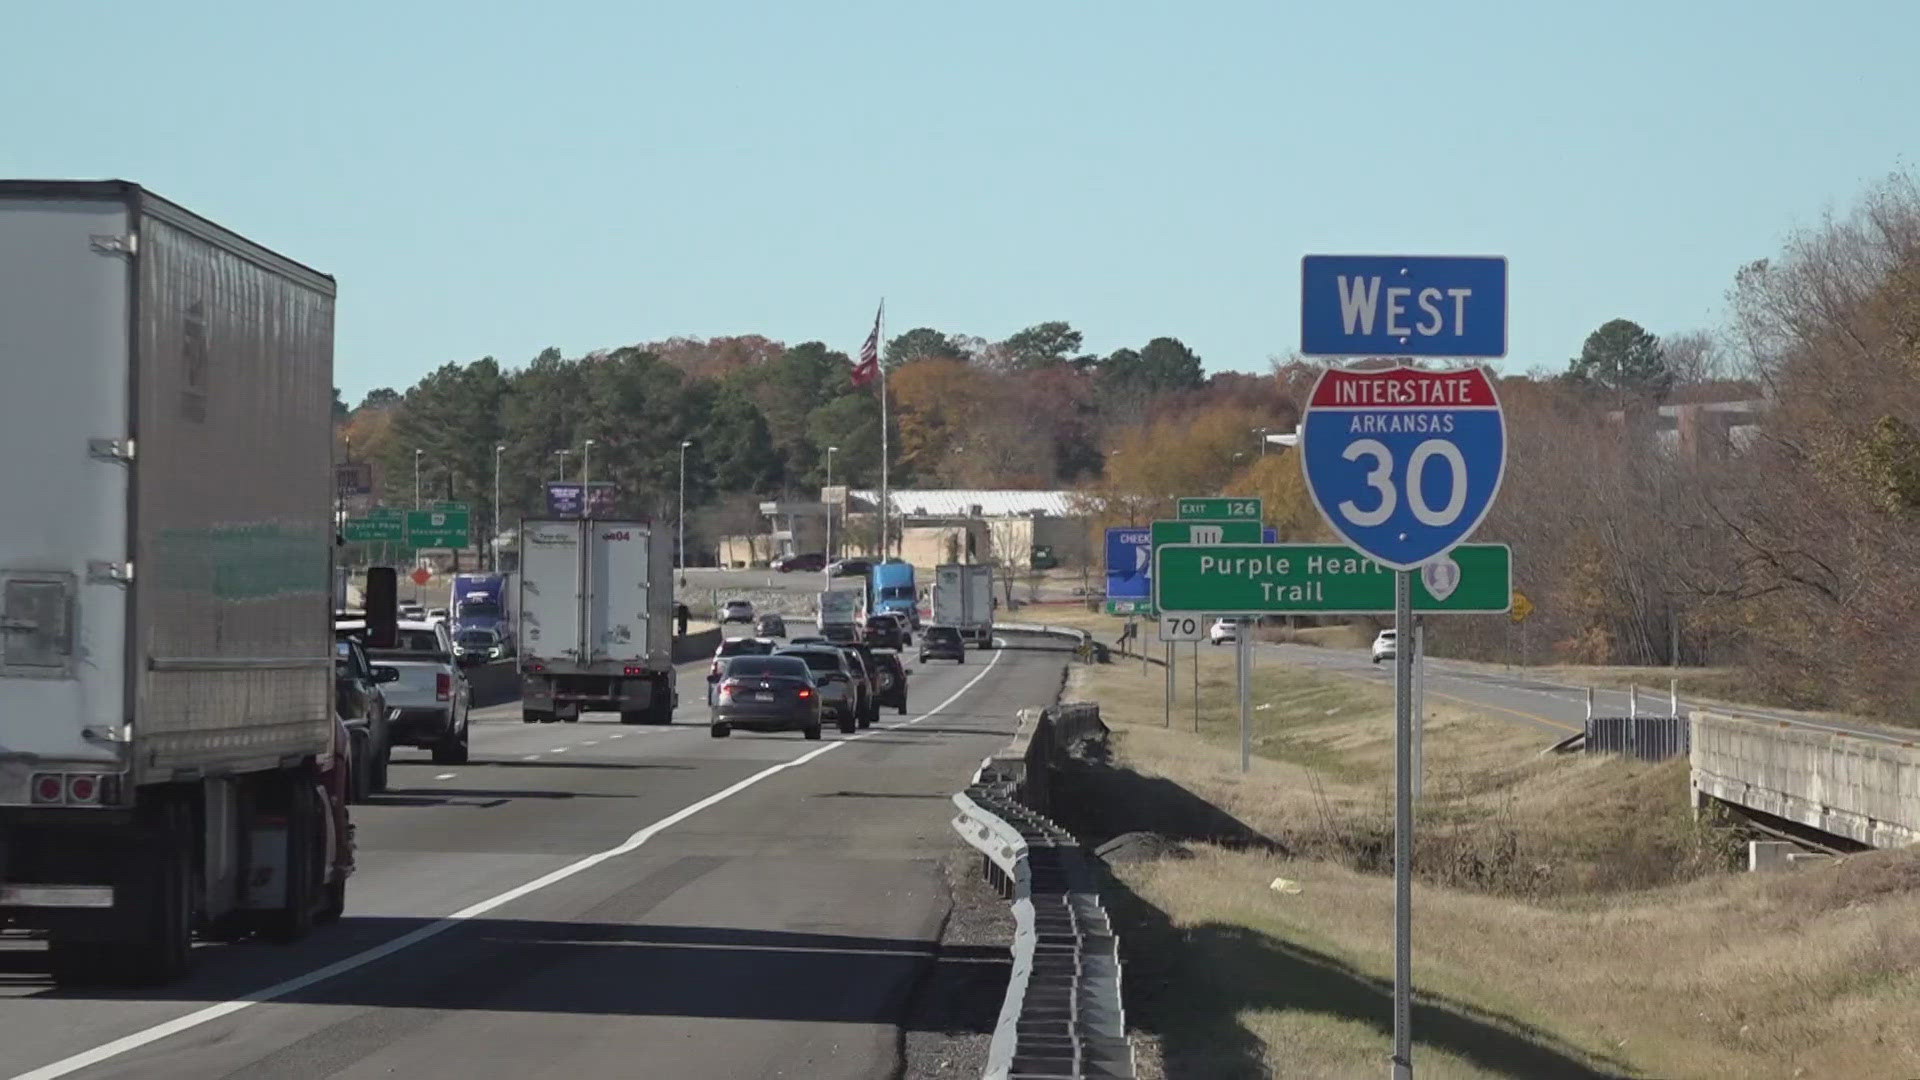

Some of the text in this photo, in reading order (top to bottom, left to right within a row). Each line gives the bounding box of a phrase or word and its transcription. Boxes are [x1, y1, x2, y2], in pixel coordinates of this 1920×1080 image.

[1337, 275, 1473, 337] WEST
[1335, 379, 1473, 404] INTERSTATE
[1350, 414, 1455, 434] ARKANSAS
[1338, 438, 1468, 528] 30
[1181, 502, 1256, 516] EXIT 126
[1200, 555, 1383, 579] Purple Heart
[1260, 582, 1324, 602] Trail
[1166, 618, 1196, 635] 70
